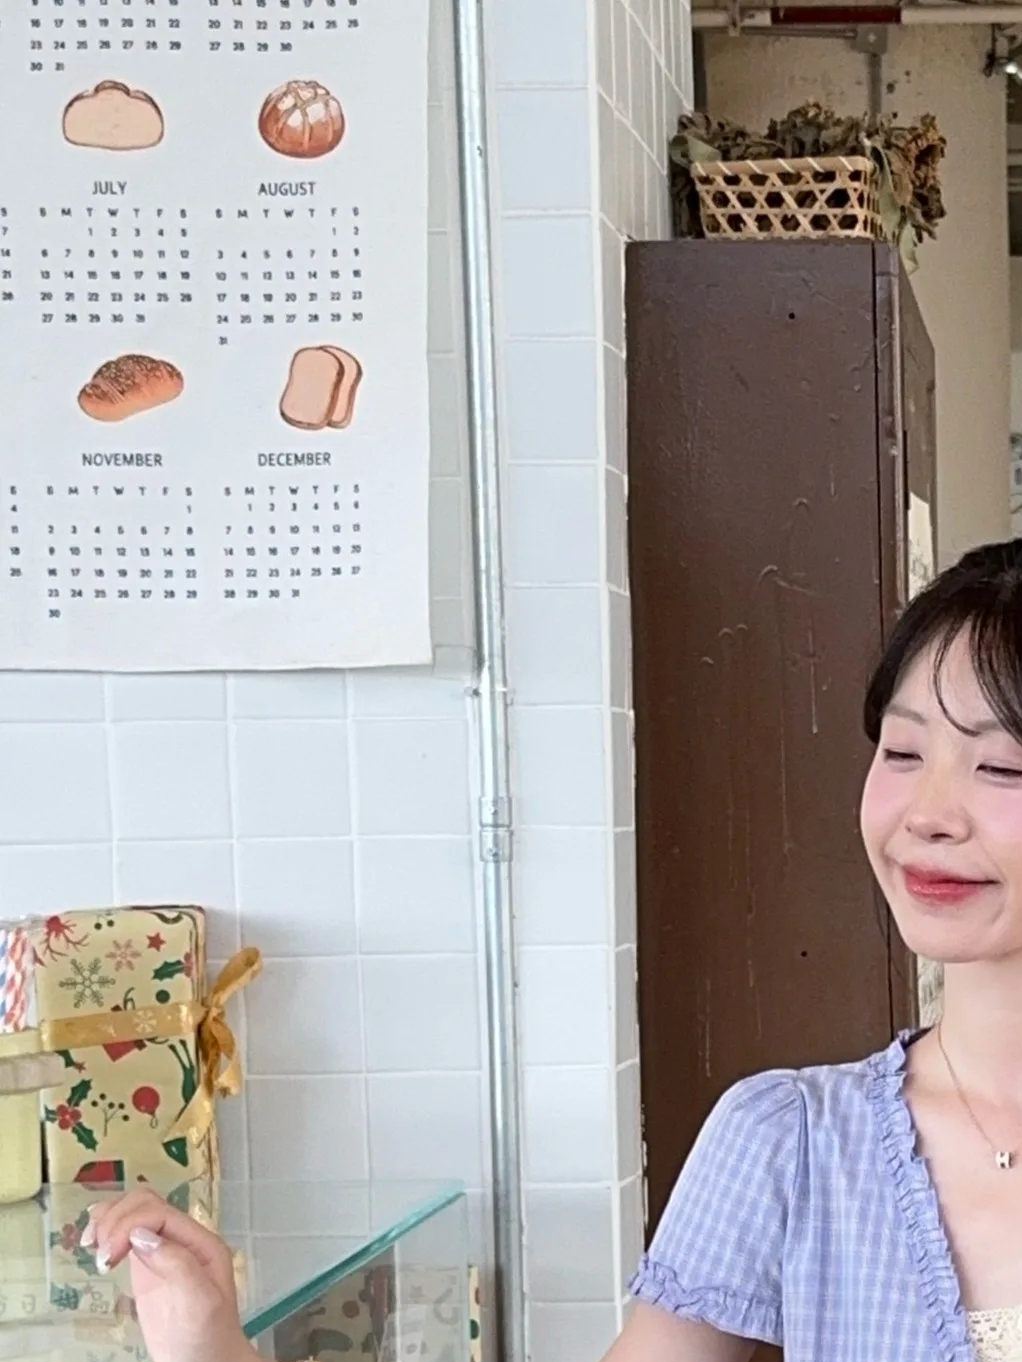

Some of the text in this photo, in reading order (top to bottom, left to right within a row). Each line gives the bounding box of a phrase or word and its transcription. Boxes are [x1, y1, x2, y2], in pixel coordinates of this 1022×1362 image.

[91, 180, 128, 196] JULY
[257, 181, 317, 197] AUGUST
[81, 452, 163, 468] NOVEMBER
[257, 451, 331, 467] DECEMBER
